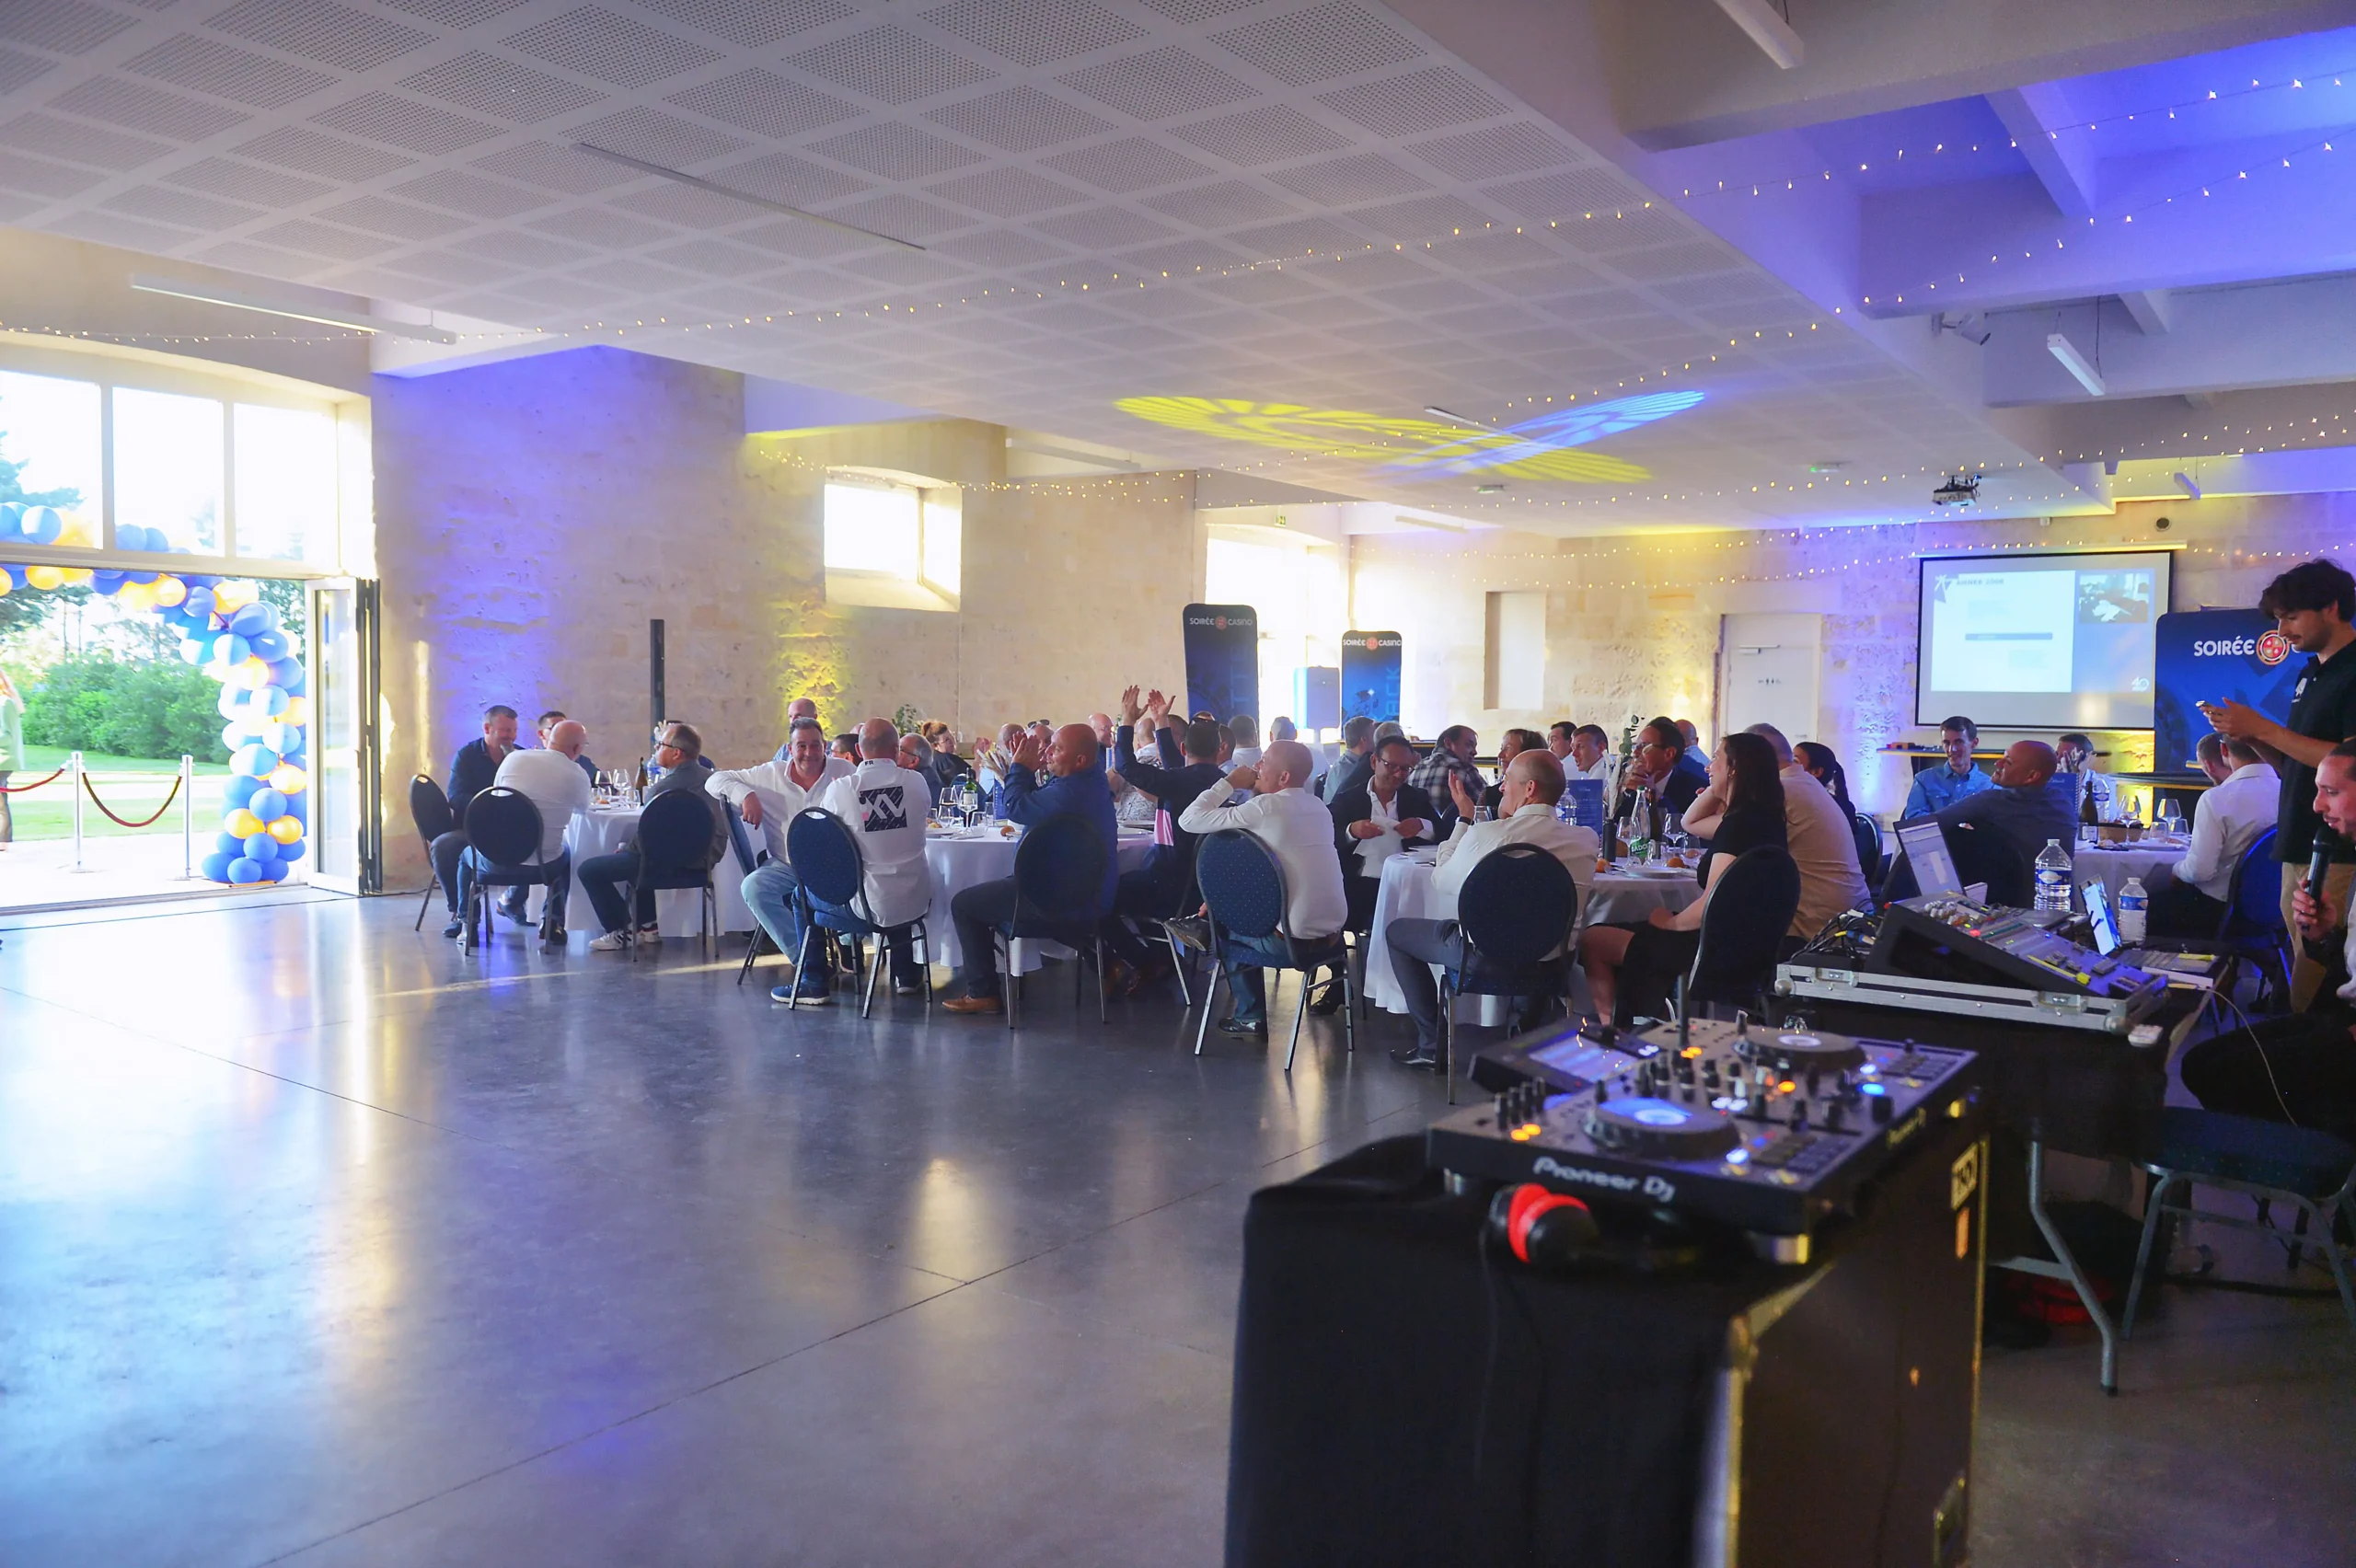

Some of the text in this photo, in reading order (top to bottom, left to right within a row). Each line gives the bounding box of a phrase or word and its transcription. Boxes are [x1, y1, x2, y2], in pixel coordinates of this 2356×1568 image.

[1189, 617, 1215, 626] SOIRÉE
[1343, 638, 1402, 647] SOIRÉE CASINO
[2193, 635, 2255, 657] SOIRÉE
[1532, 1155, 1640, 1191] Pioneer
